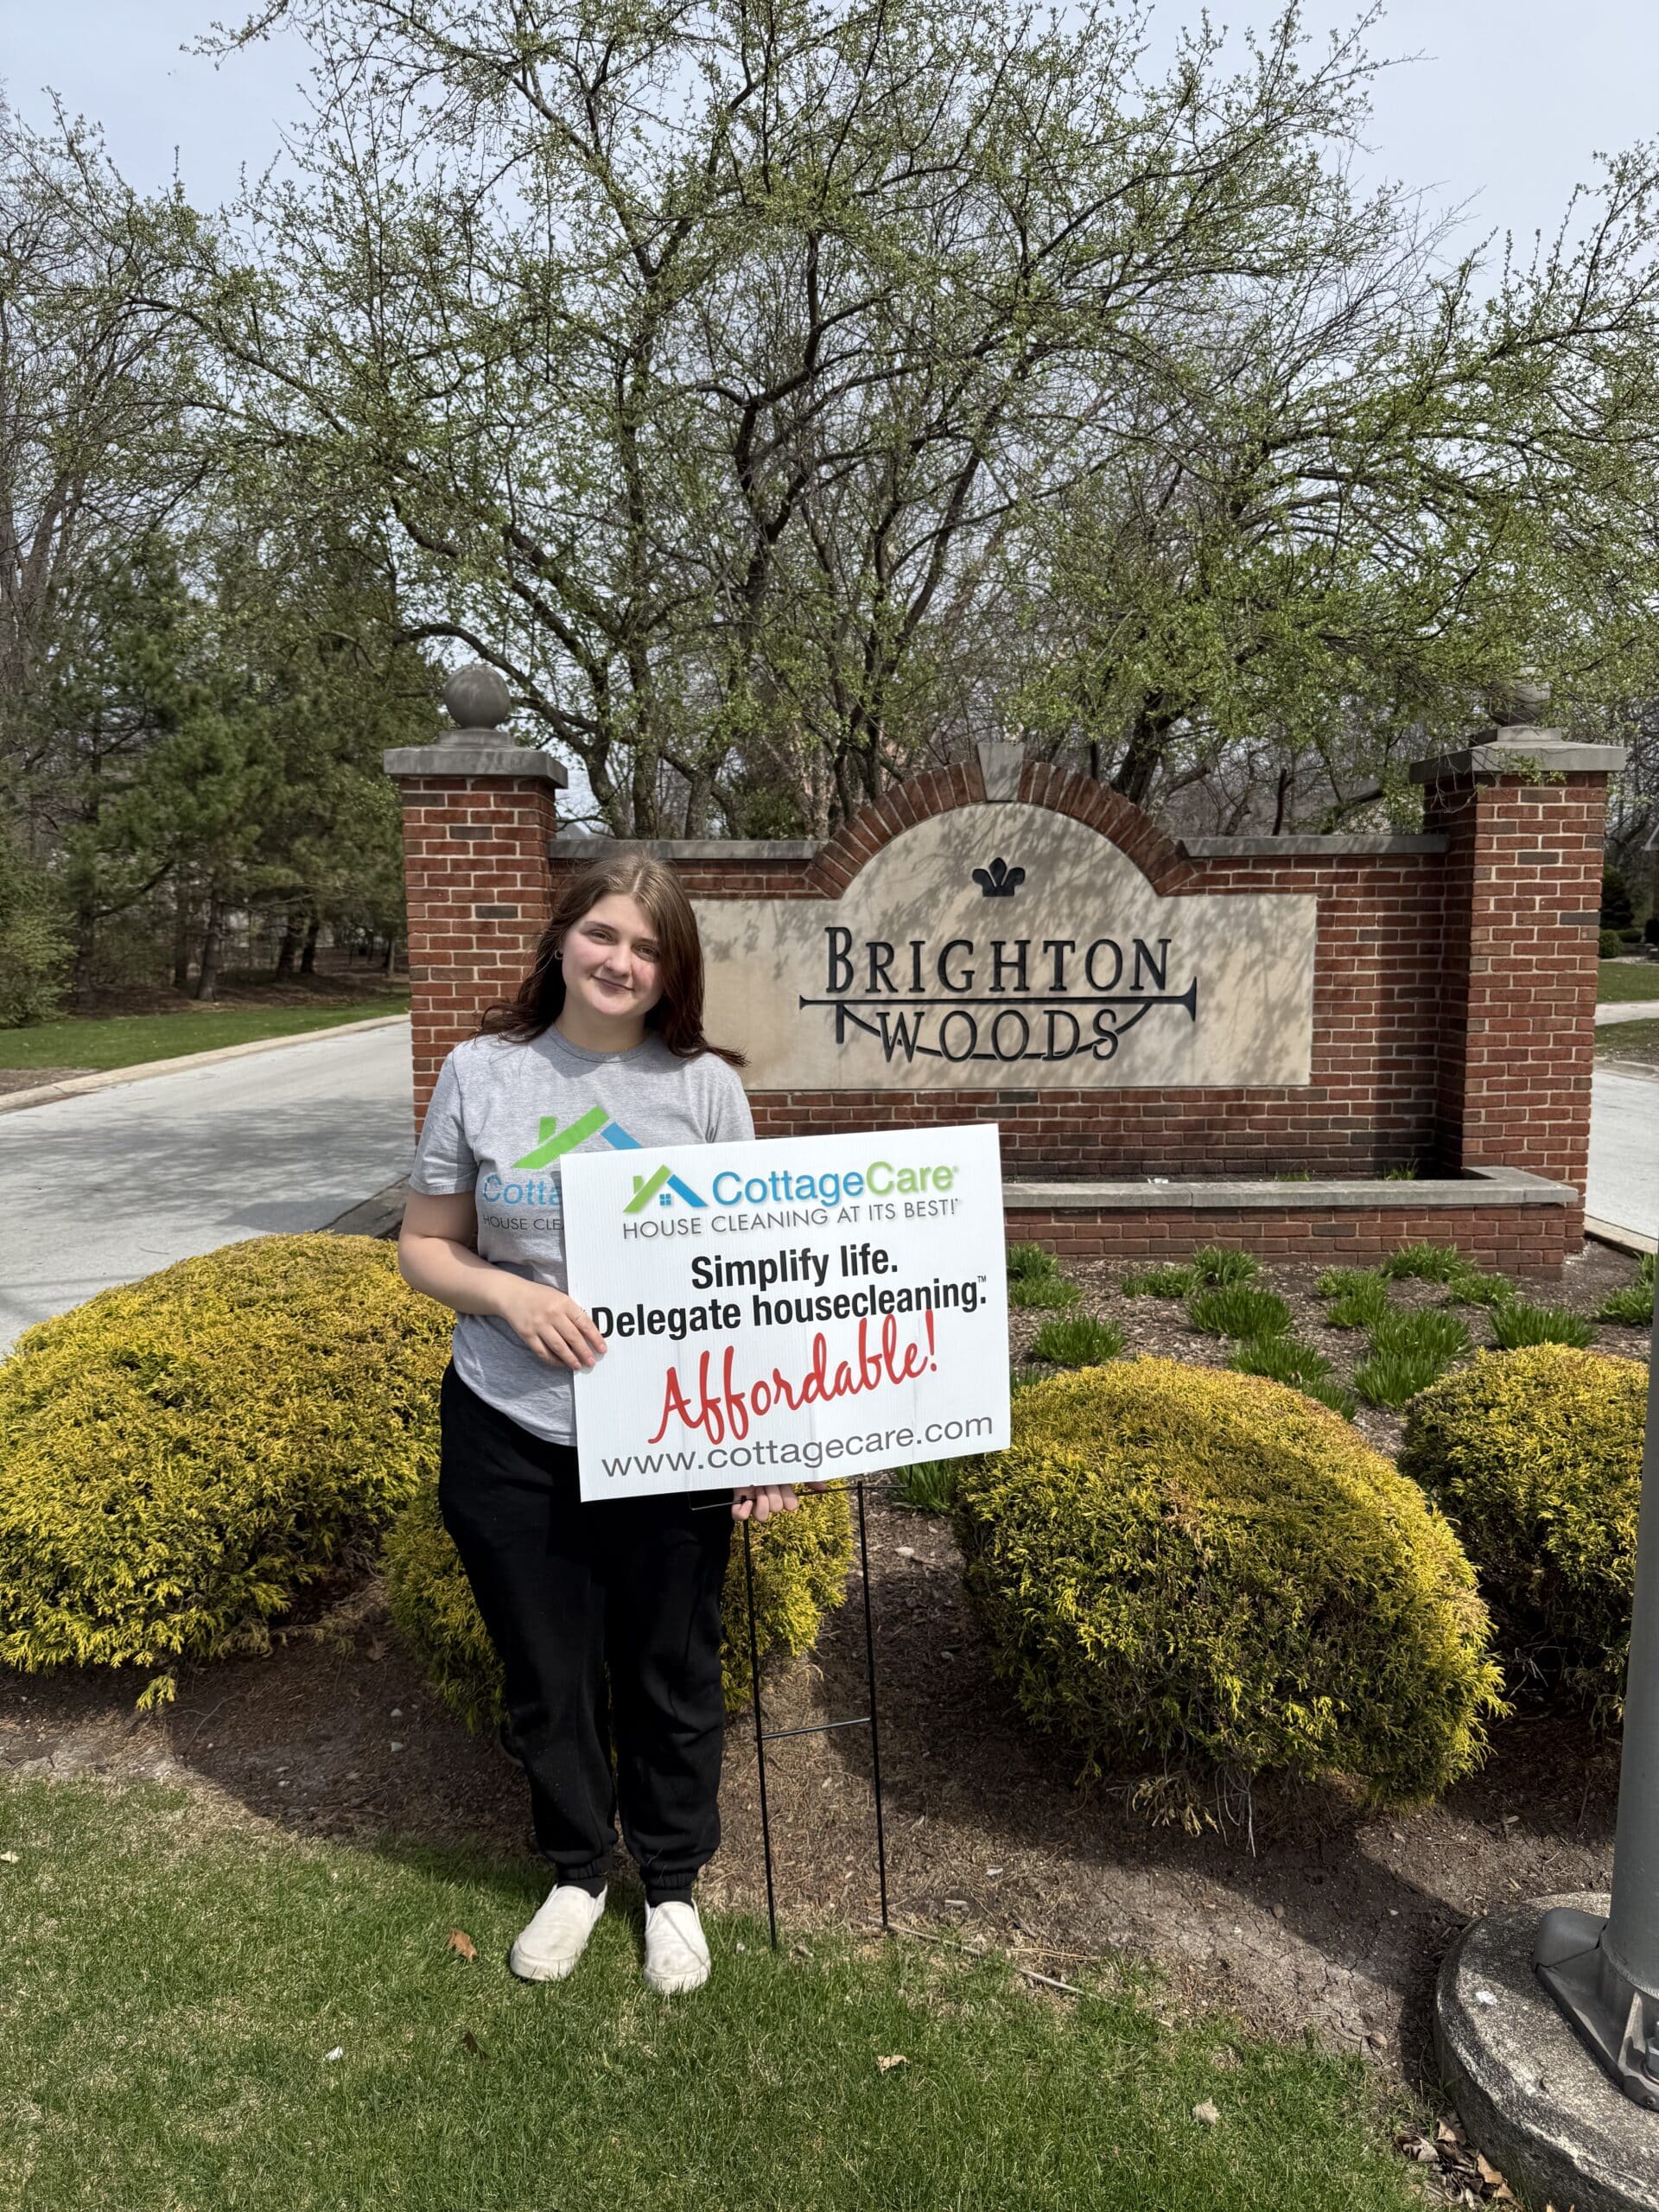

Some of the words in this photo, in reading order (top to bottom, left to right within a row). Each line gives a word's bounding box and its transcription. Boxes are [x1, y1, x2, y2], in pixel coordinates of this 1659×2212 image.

[824, 926, 1172, 994] BRIGHTON
[875, 1007, 1119, 1063] WOODS
[482, 1215, 527, 1230] HOUSE
[622, 1217, 702, 1240] HOUSE
[711, 1208, 829, 1233] CLEANING
[836, 1205, 861, 1224] AT
[868, 1203, 896, 1221] ITS
[904, 1198, 955, 1218] BEST!
[691, 1247, 830, 1290] Simplify
[840, 1243, 899, 1277] life.
[591, 1304, 741, 1341] Delegate
[647, 1308, 938, 1445] Affordable!
[601, 1416, 993, 1478] www.cottagecare.com
